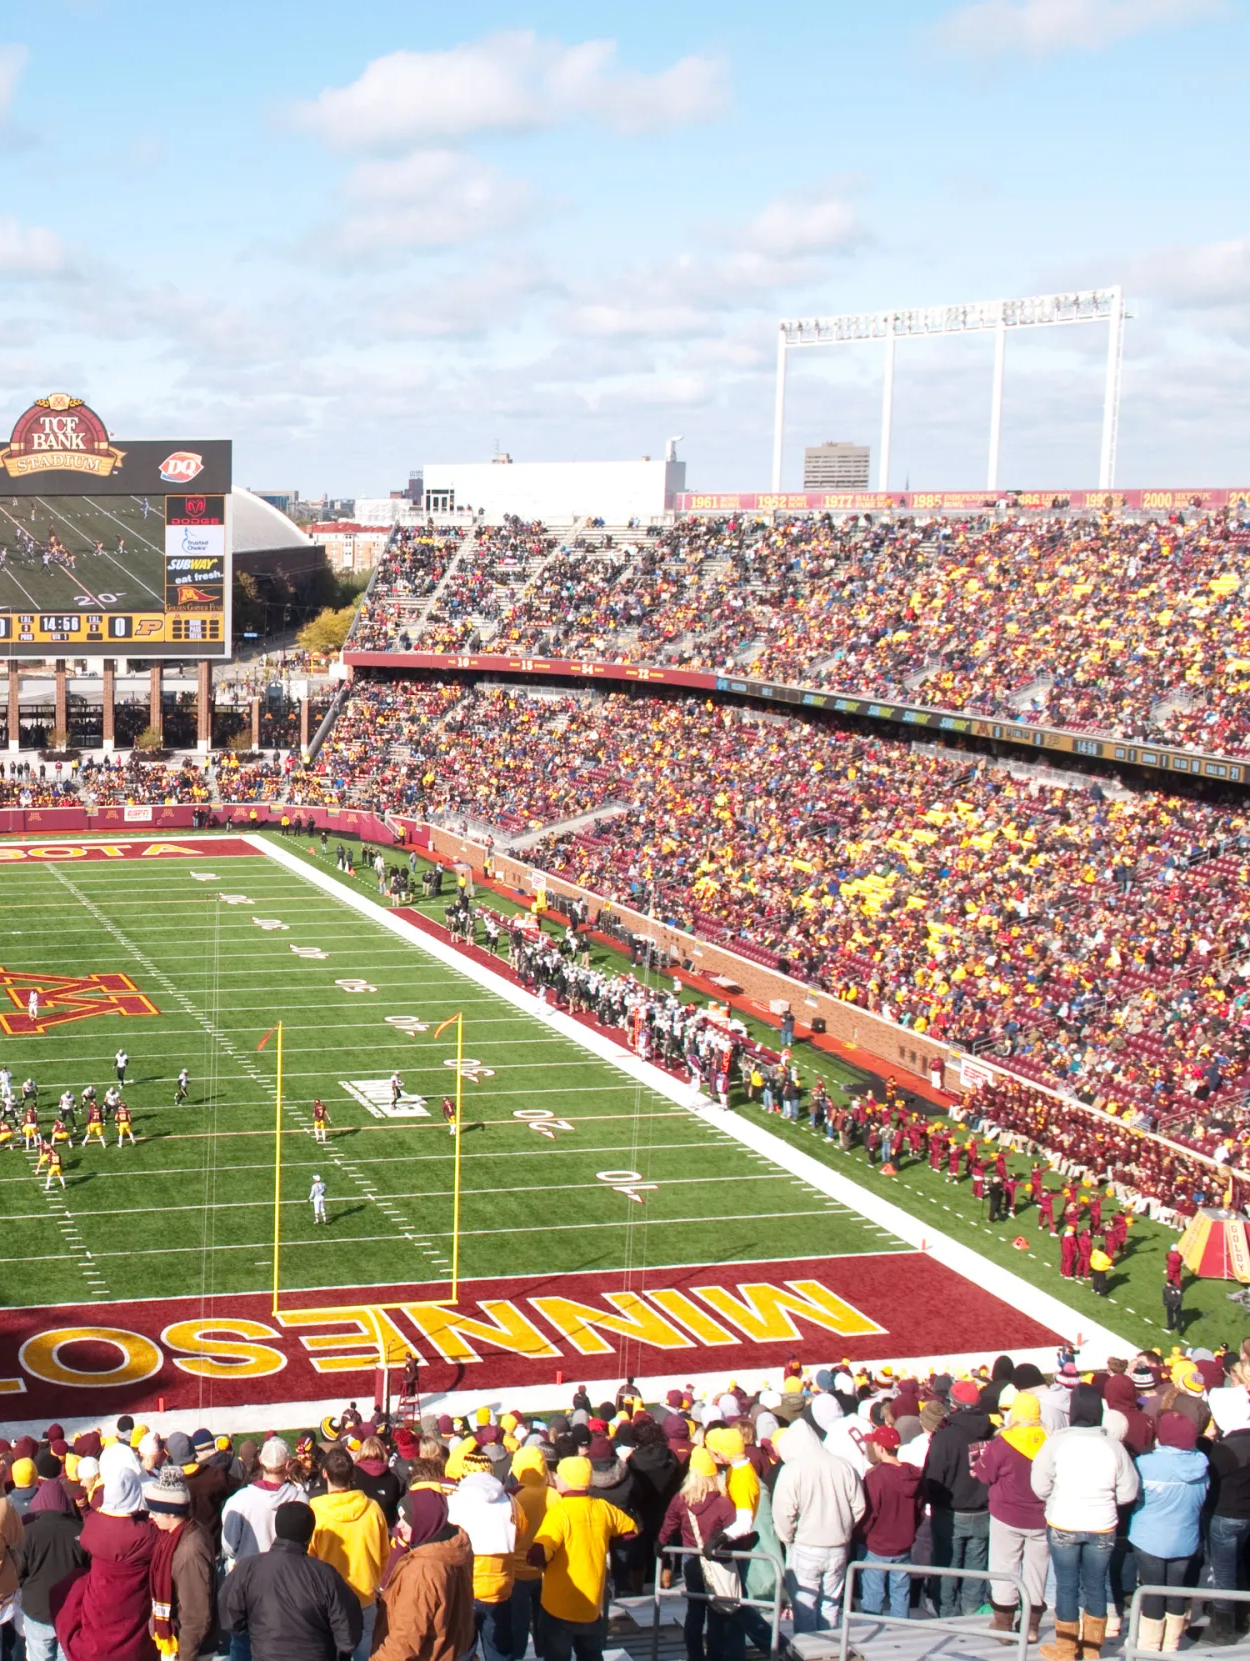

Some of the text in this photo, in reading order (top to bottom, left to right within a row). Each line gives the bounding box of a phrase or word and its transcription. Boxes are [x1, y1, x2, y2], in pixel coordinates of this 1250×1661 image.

[40, 416, 79, 434] TCF
[31, 433, 86, 450] BANK
[16, 453, 101, 473] STADIUM
[167, 459, 196, 476] DQ
[691, 496, 717, 509] 1961
[824, 495, 853, 508] 1977
[913, 494, 941, 508] 1985
[1143, 492, 1172, 508] 2000
[171, 517, 219, 525] DODGE
[167, 558, 218, 571] SUBWAY
[175, 574, 193, 584] eat
[43, 617, 79, 631] 14:56
[114, 617, 126, 637] 0
[457, 657, 470, 668] 10
[521, 660, 533, 670] 15
[581, 664, 594, 674] 54
[334, 978, 379, 993] 50
[384, 1015, 431, 1032] 40
[511, 1109, 576, 1131] 20
[595, 1170, 661, 1195] 10
[1230, 1225, 1245, 1272] GOLDY
